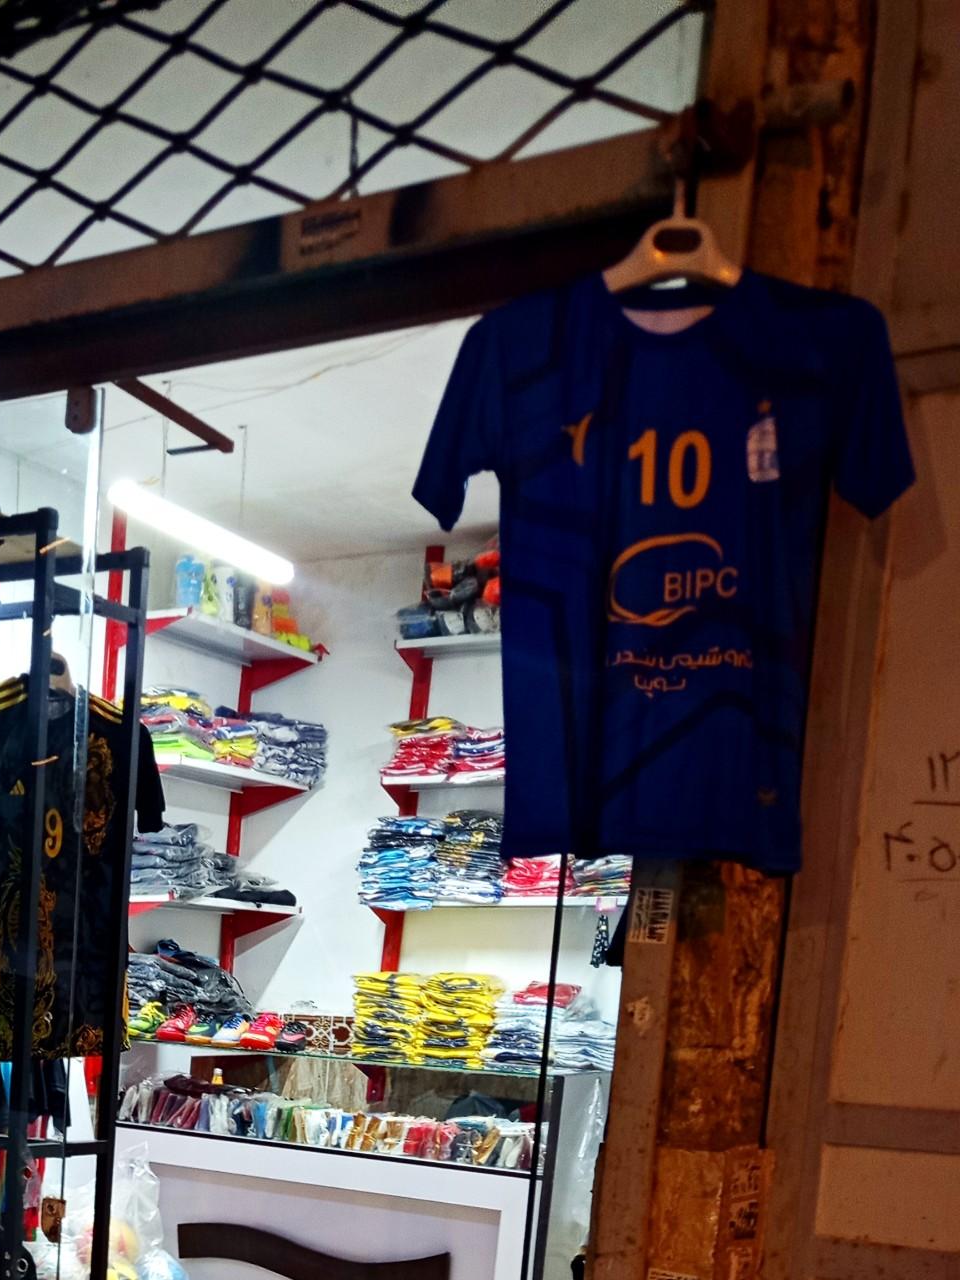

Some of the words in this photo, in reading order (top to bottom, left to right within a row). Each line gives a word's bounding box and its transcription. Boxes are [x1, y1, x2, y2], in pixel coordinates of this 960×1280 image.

[628, 428, 712, 509] 10
[663, 566, 738, 602] BIPC
[43, 808, 62, 858] 9
